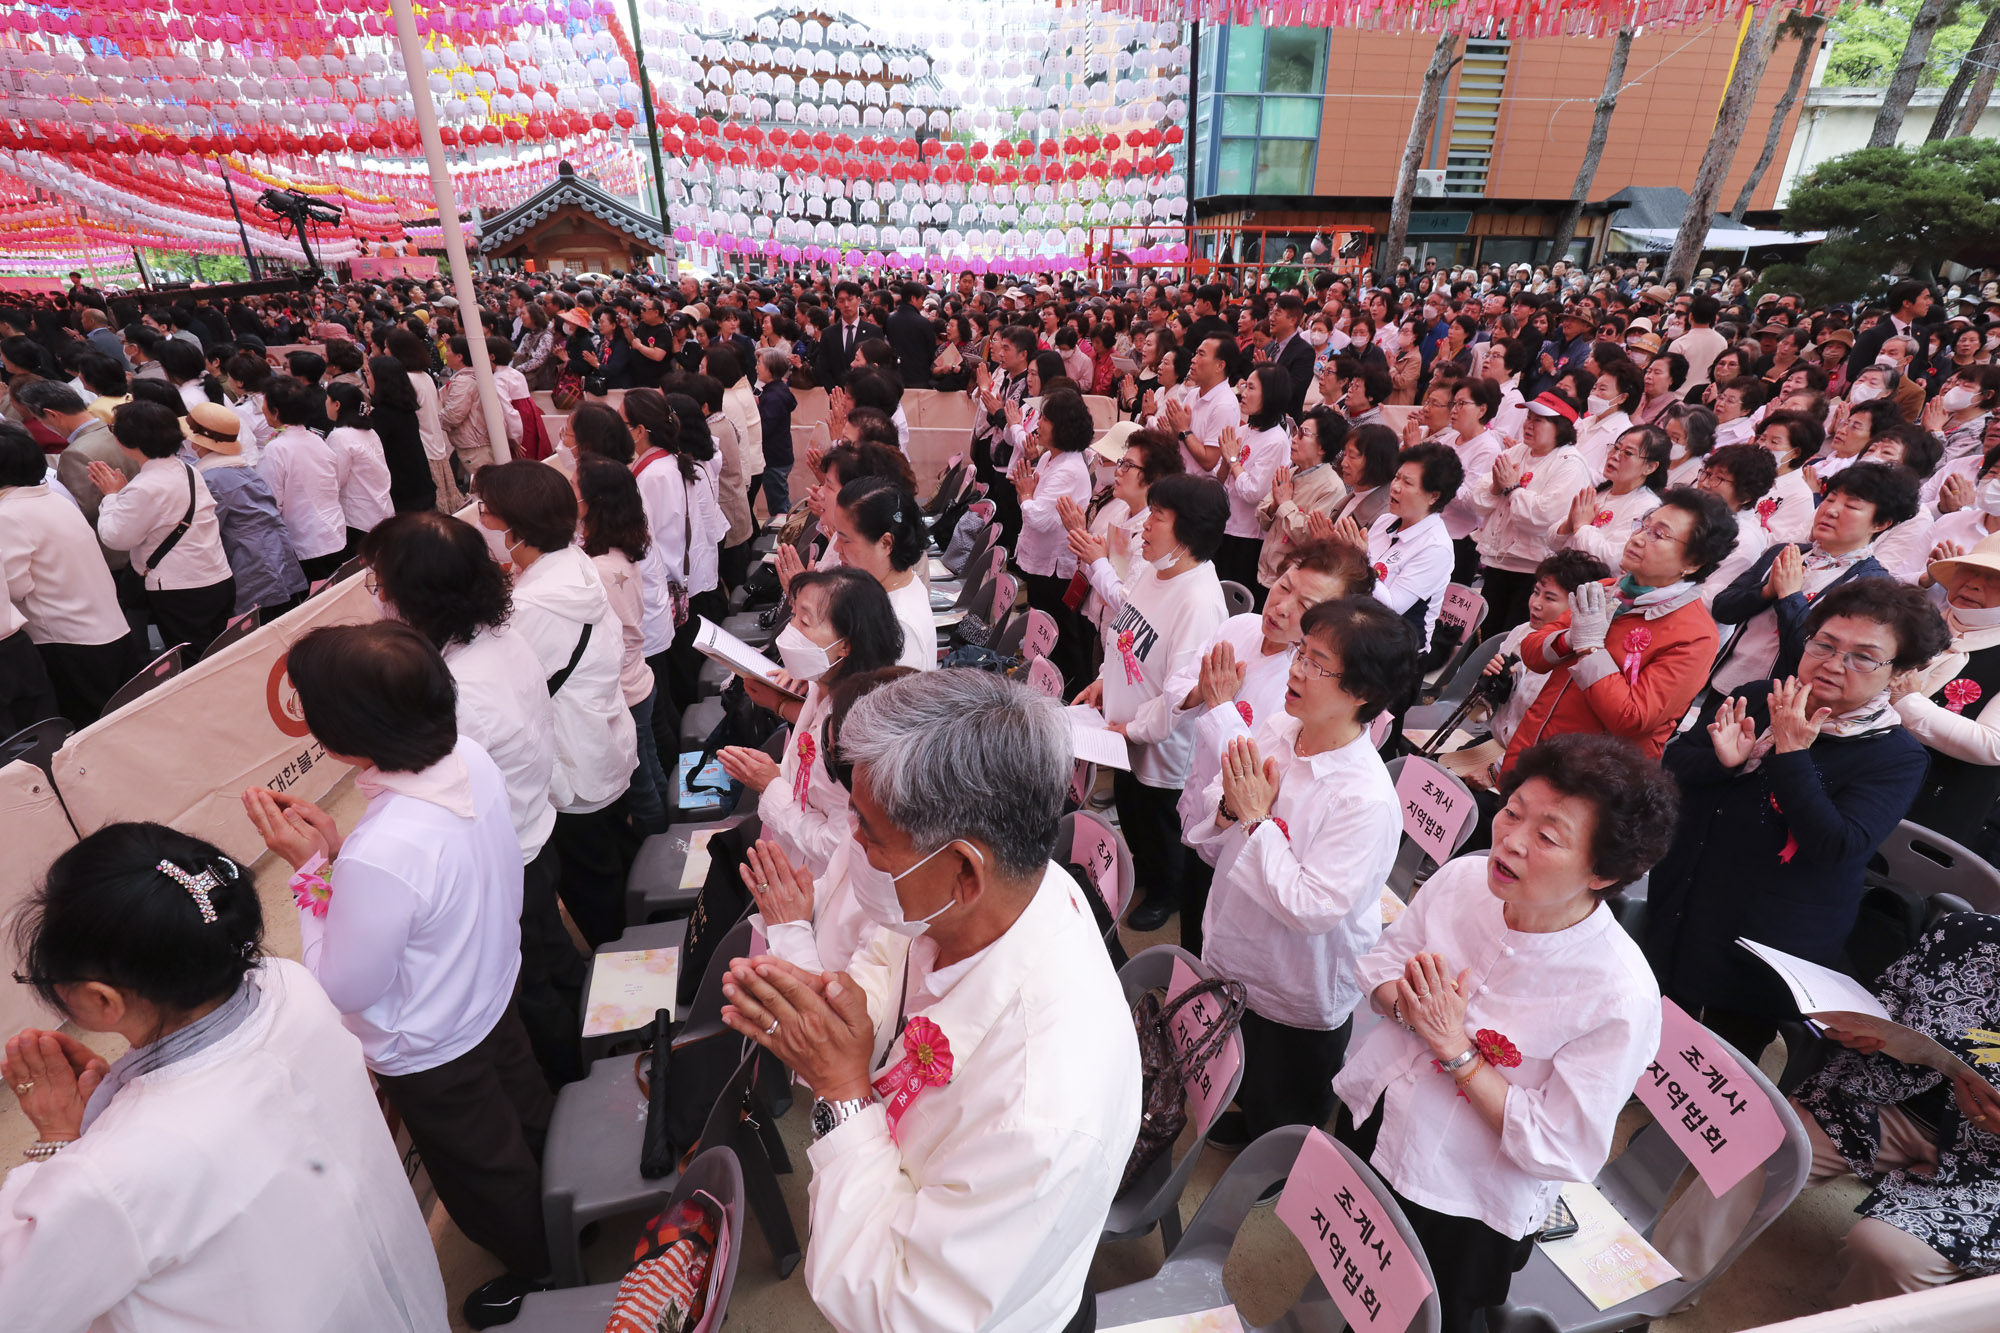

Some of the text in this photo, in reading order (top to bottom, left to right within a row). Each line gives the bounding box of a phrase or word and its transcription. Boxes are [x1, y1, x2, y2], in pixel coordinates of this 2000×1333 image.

[1450, 594, 1472, 611] 조계사
[1406, 800, 1446, 843] 지역법회
[1421, 780, 1454, 813] 조계사
[1097, 838, 1114, 871] 조계
[1646, 1060, 1728, 1154] 지역법회
[1679, 1045, 1747, 1116] 조계사
[1333, 1185, 1392, 1272] 조계사
[1310, 1207, 1382, 1322] 지역법회
